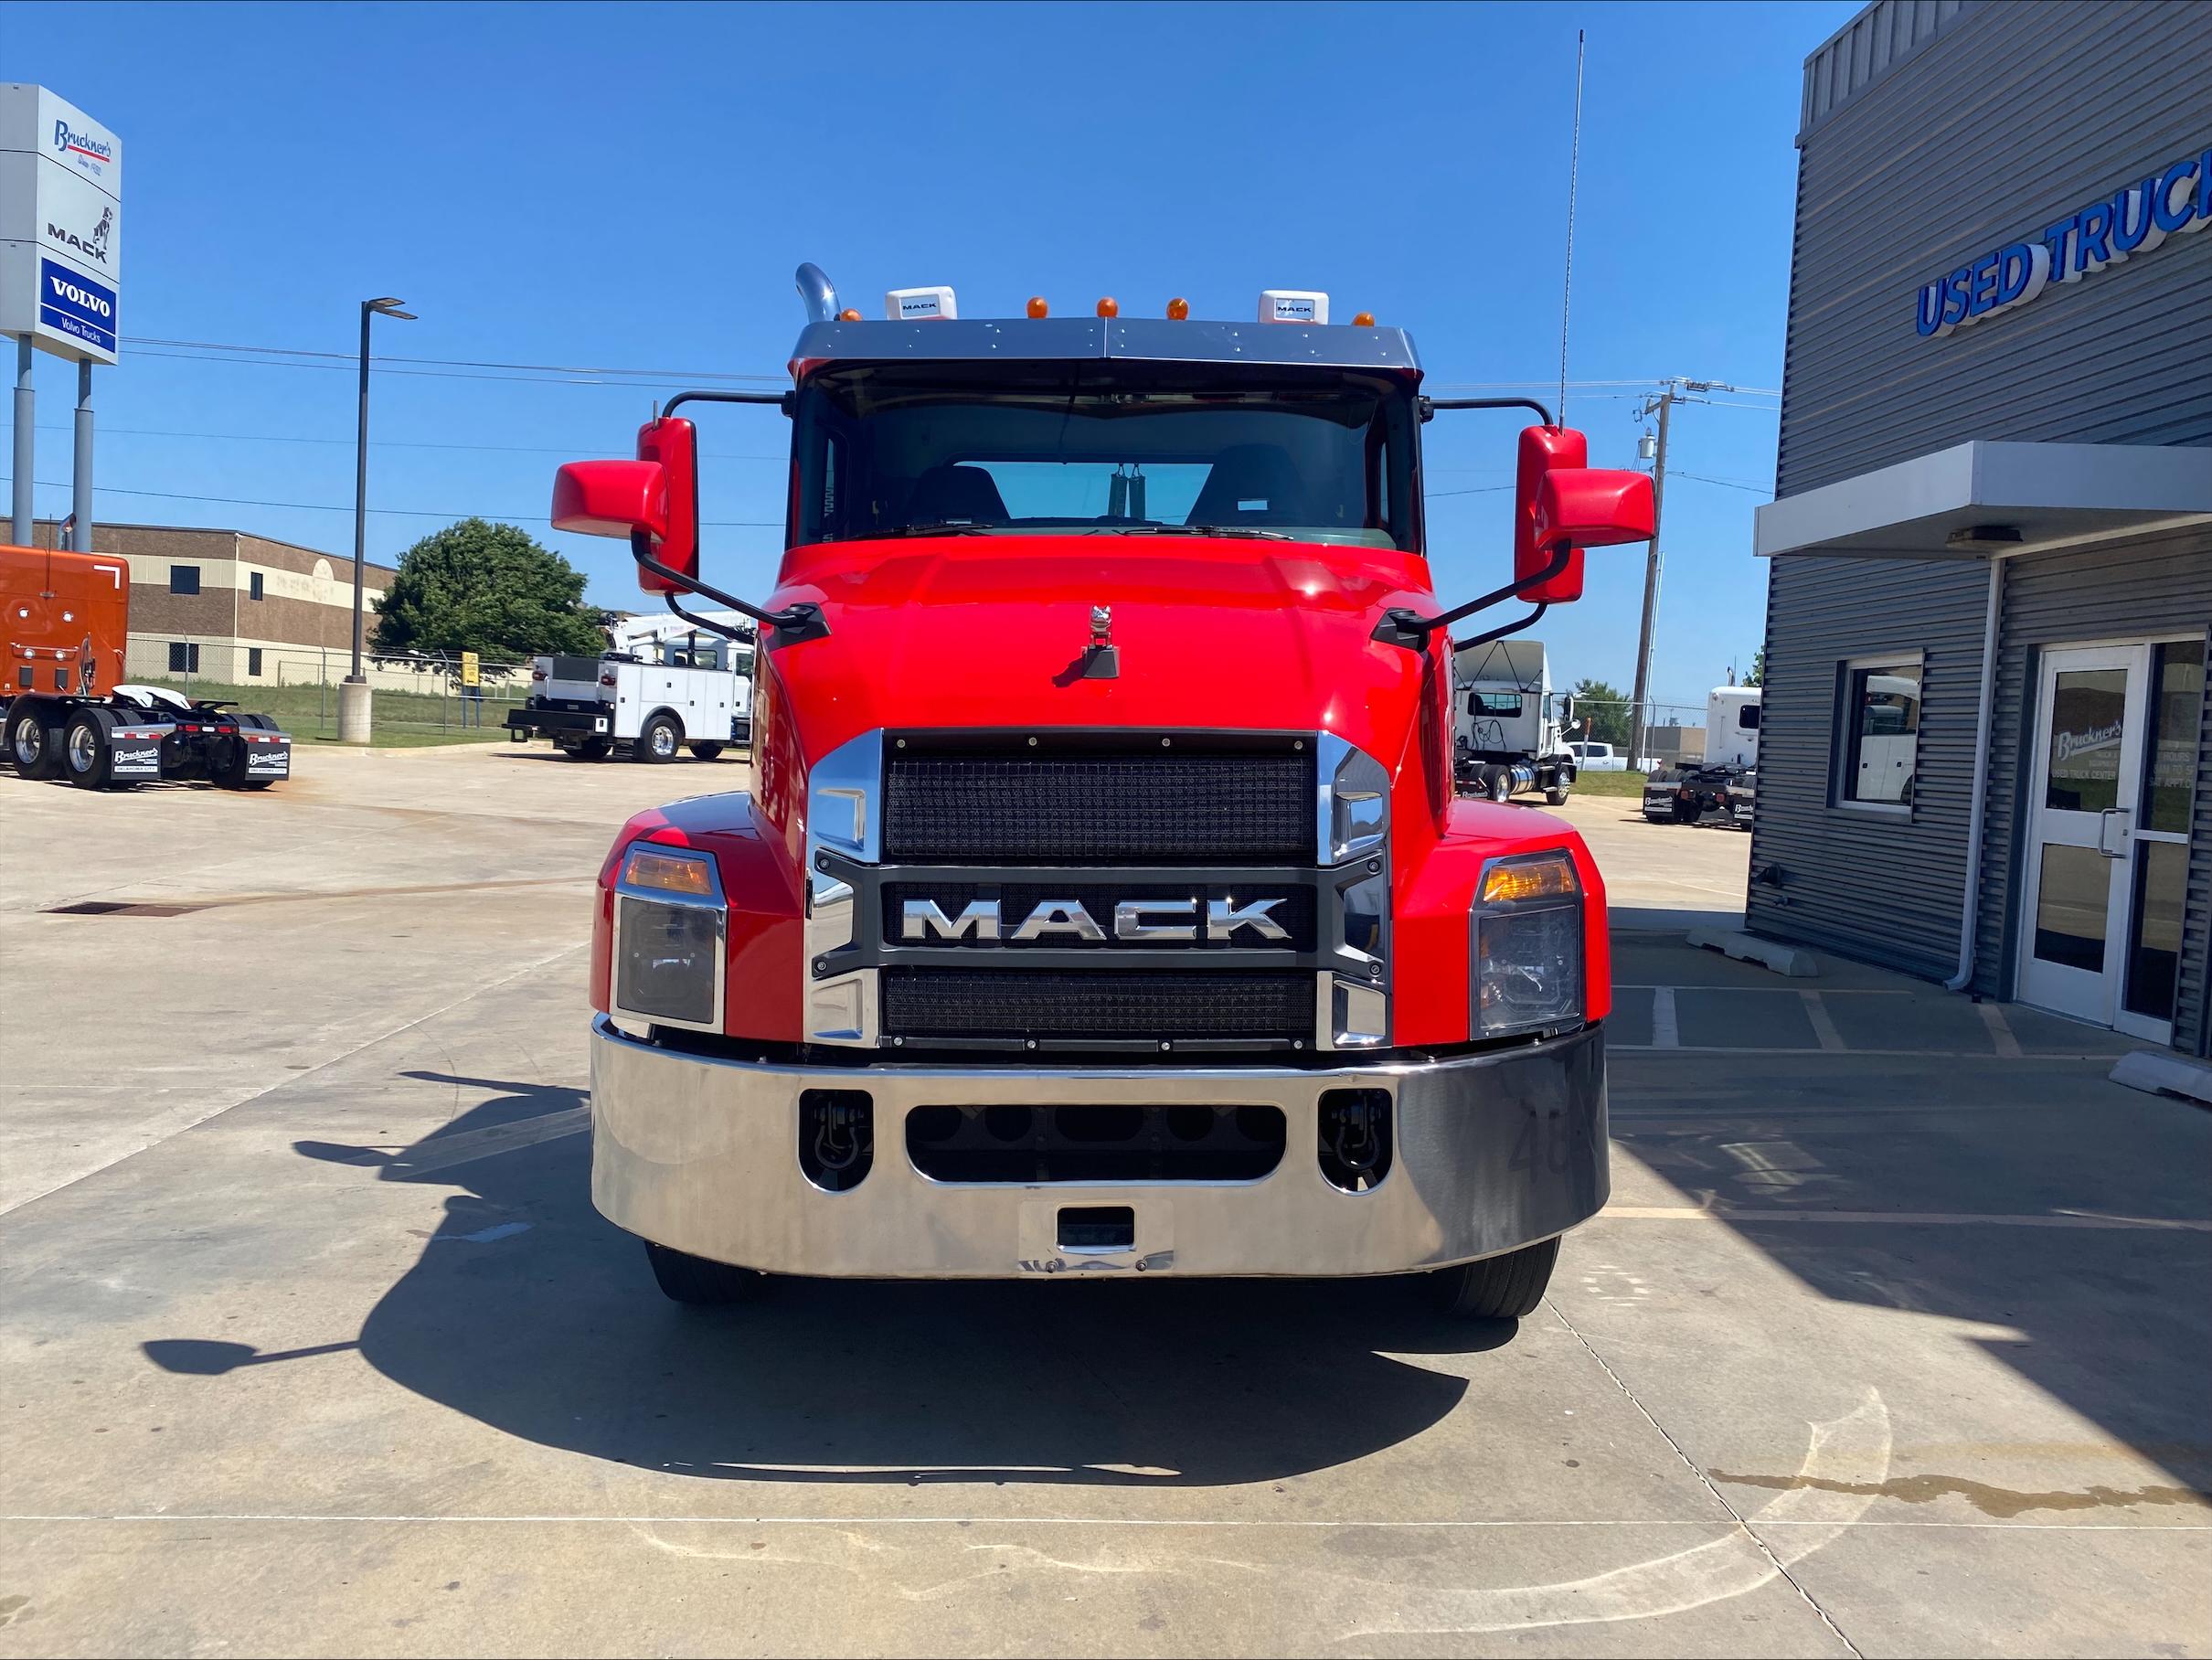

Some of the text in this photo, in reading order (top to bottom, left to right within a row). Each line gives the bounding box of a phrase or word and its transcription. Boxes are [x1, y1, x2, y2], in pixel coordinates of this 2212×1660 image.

[54, 119, 112, 157] Bruckner's
[48, 222, 108, 264] MACK
[1917, 147, 2212, 337] USED TRUC
[49, 276, 111, 318] VOLVO
[902, 303, 937, 311] MACK
[61, 316, 101, 345] Volvo Trucks
[2058, 720, 2122, 761] Bruckner's
[901, 898, 1293, 941] MACK
